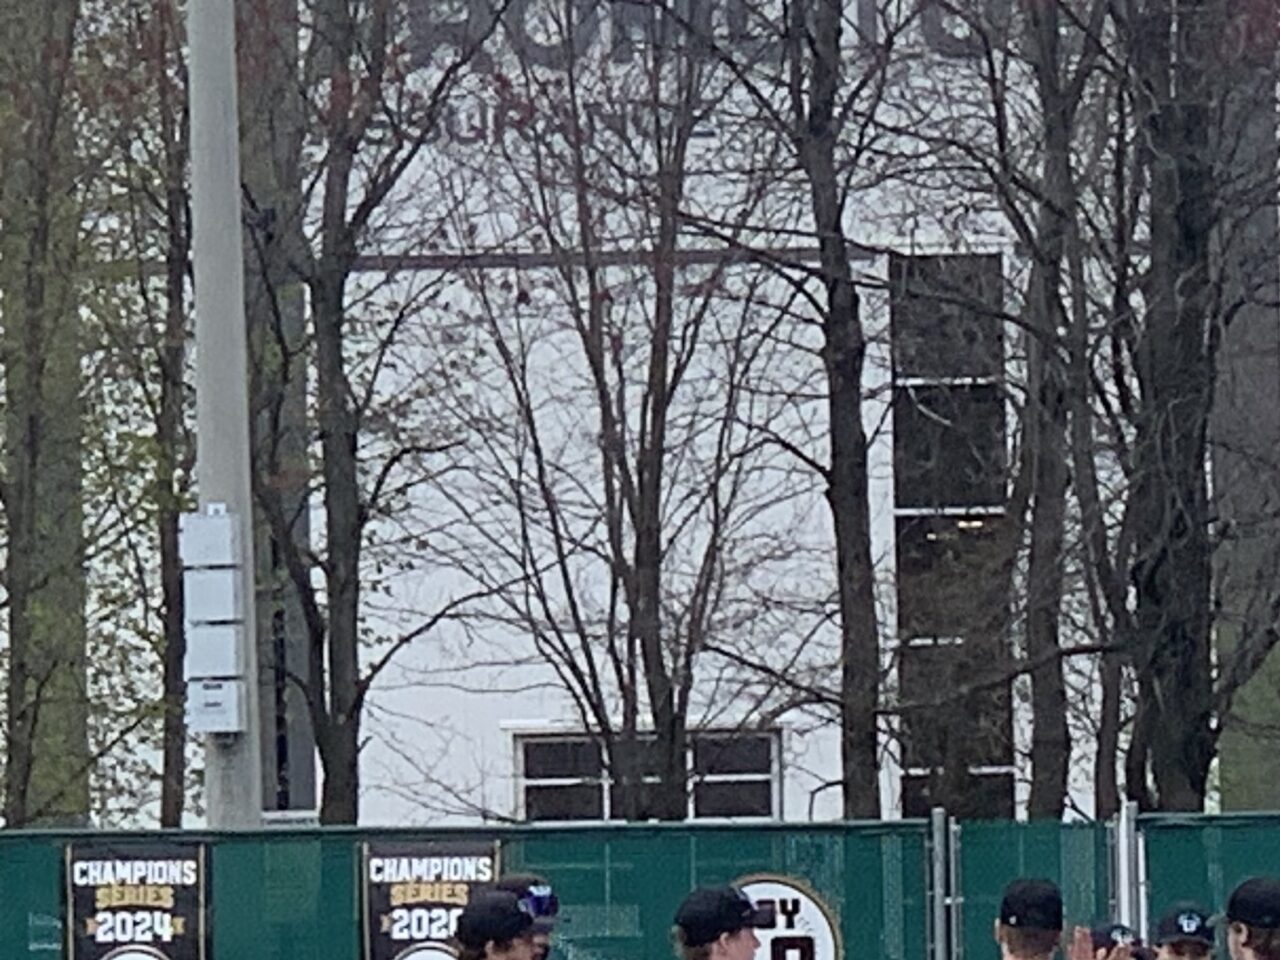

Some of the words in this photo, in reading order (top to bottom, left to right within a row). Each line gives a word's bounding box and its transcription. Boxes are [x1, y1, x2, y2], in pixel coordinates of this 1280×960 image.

[73, 860, 197, 886] CHAMPIONS
[369, 857, 492, 882] CHAMPIONS
[95, 911, 172, 941] 2024
